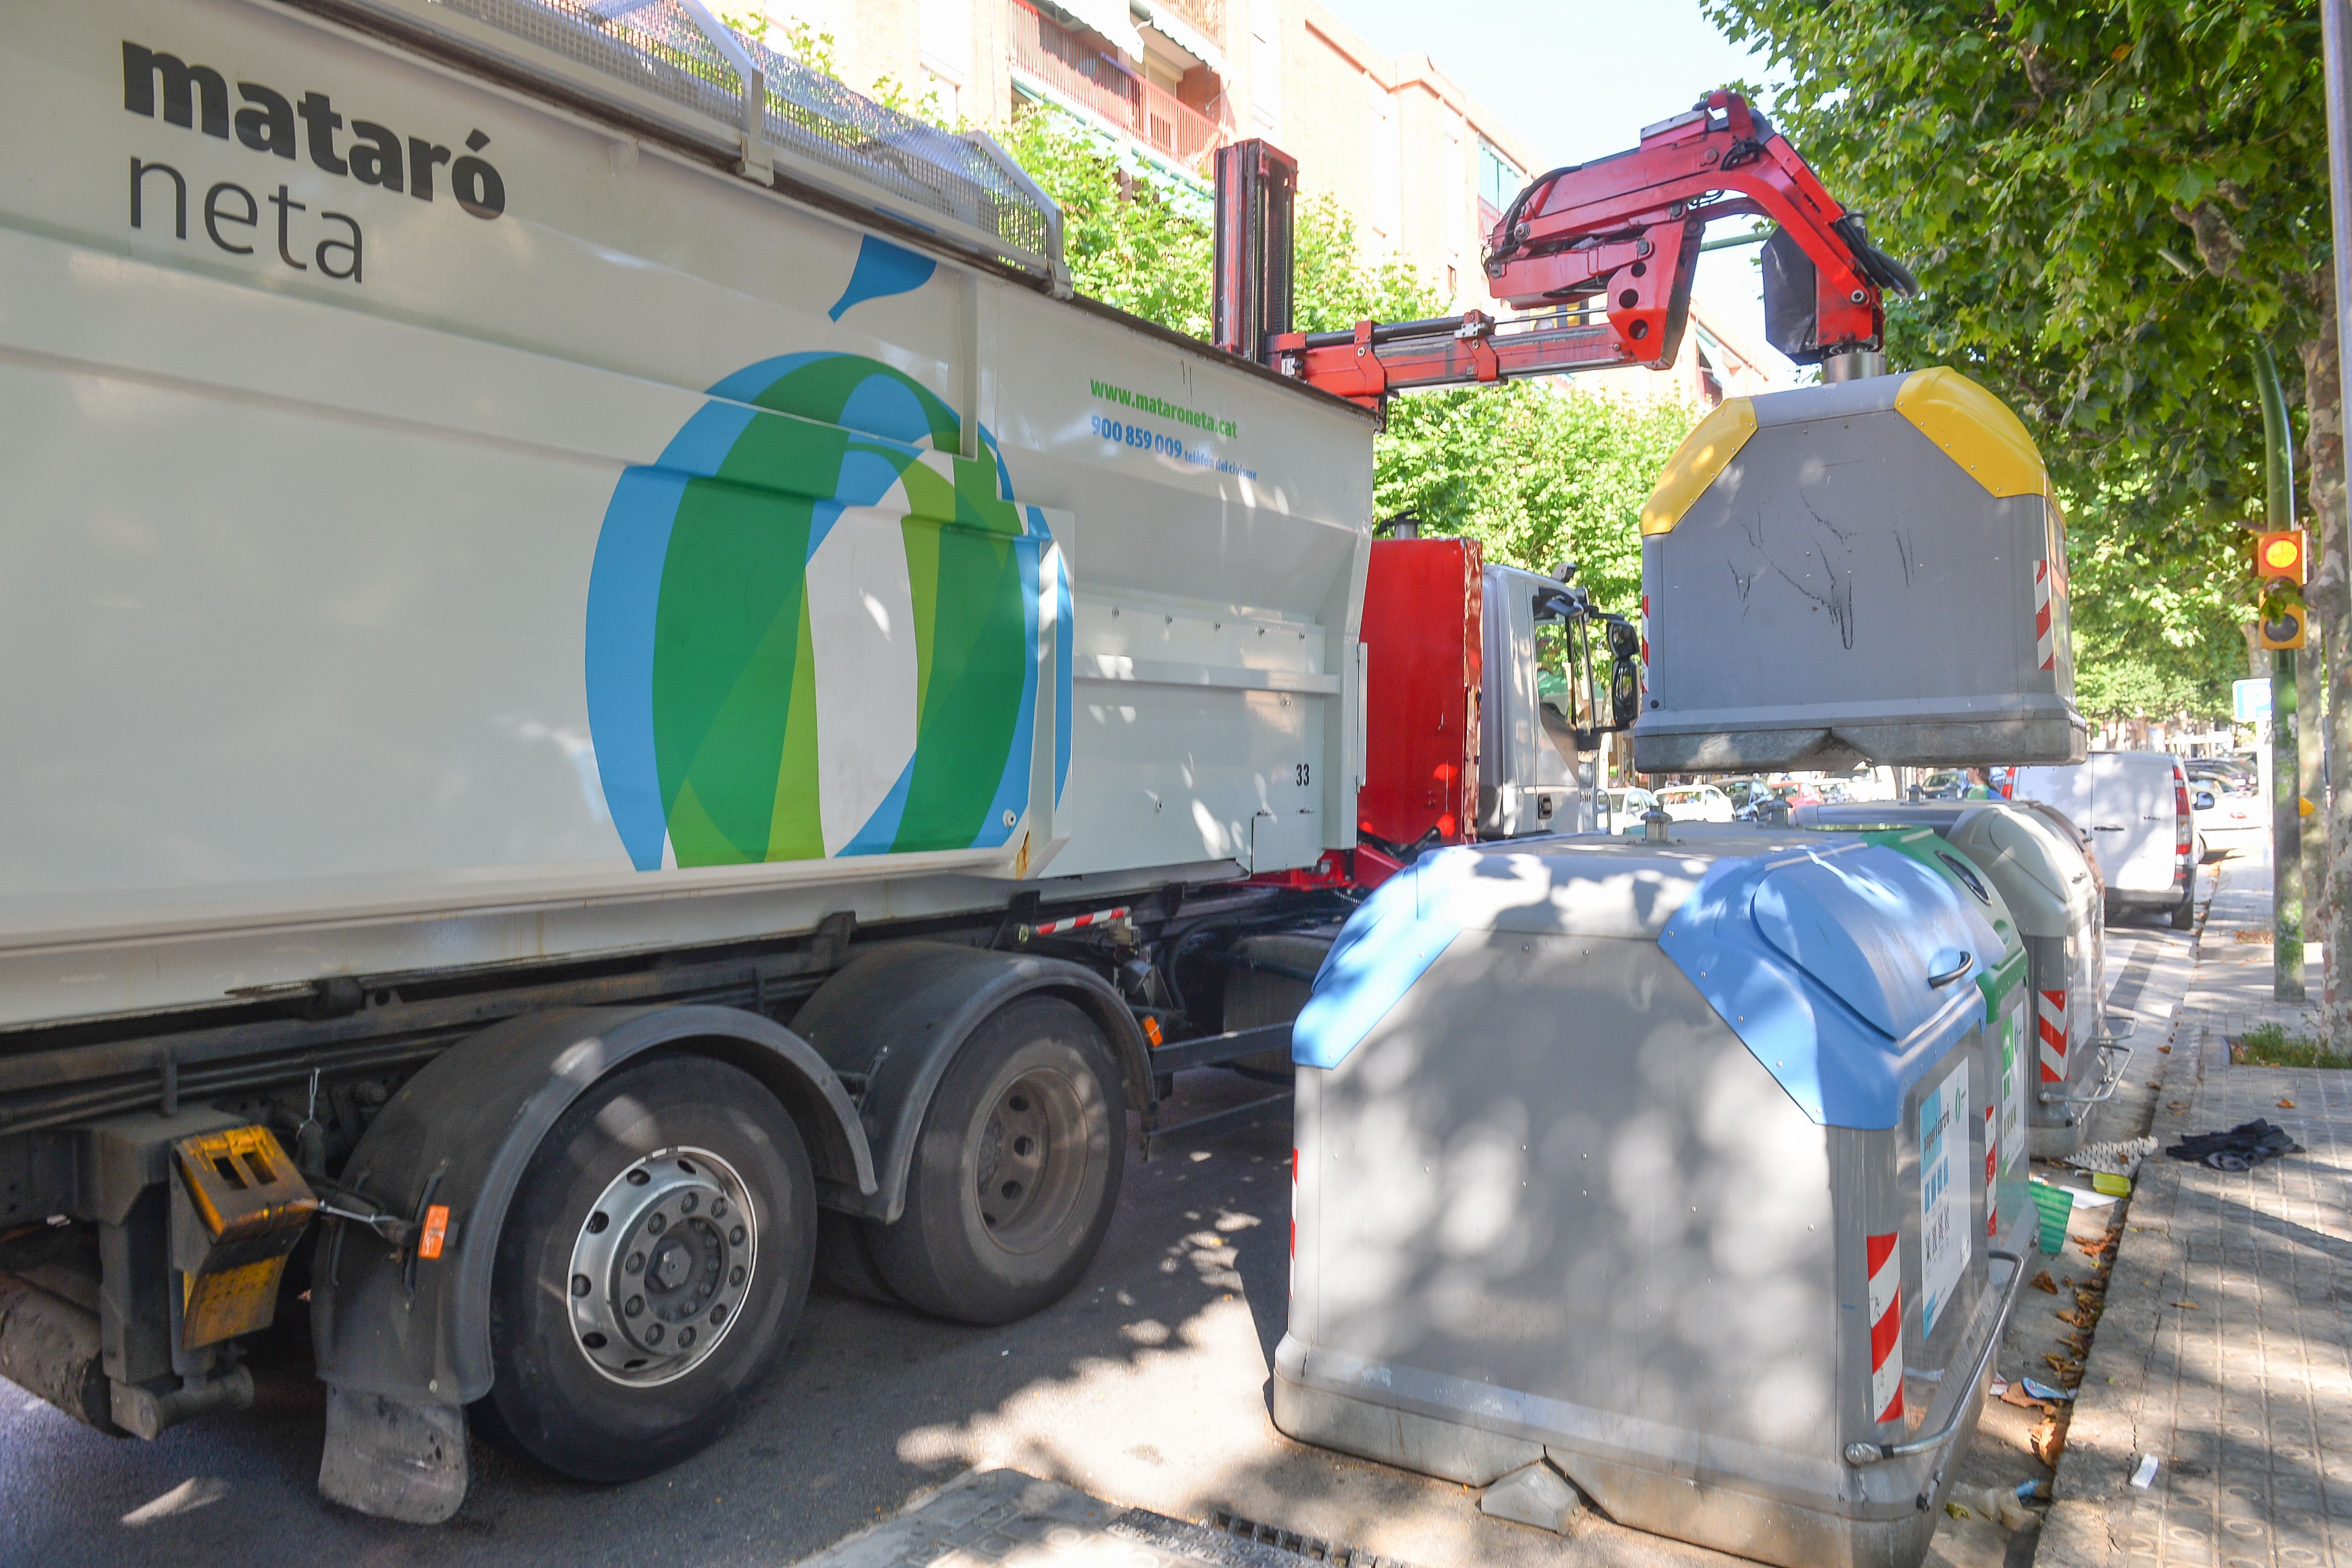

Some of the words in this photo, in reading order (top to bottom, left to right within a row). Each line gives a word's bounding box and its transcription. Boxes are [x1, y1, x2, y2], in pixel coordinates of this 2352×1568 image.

[121, 39, 506, 219] mataró
[130, 156, 362, 283] neta
[1090, 378, 1238, 439] www.mataroneta.cat
[1091, 414, 1122, 442] 900
[1125, 424, 1152, 450] 859
[1155, 433, 1182, 459] 009
[1216, 457, 1228, 474] del
[1229, 461, 1257, 481] civisme
[1296, 763, 1309, 786] 33
